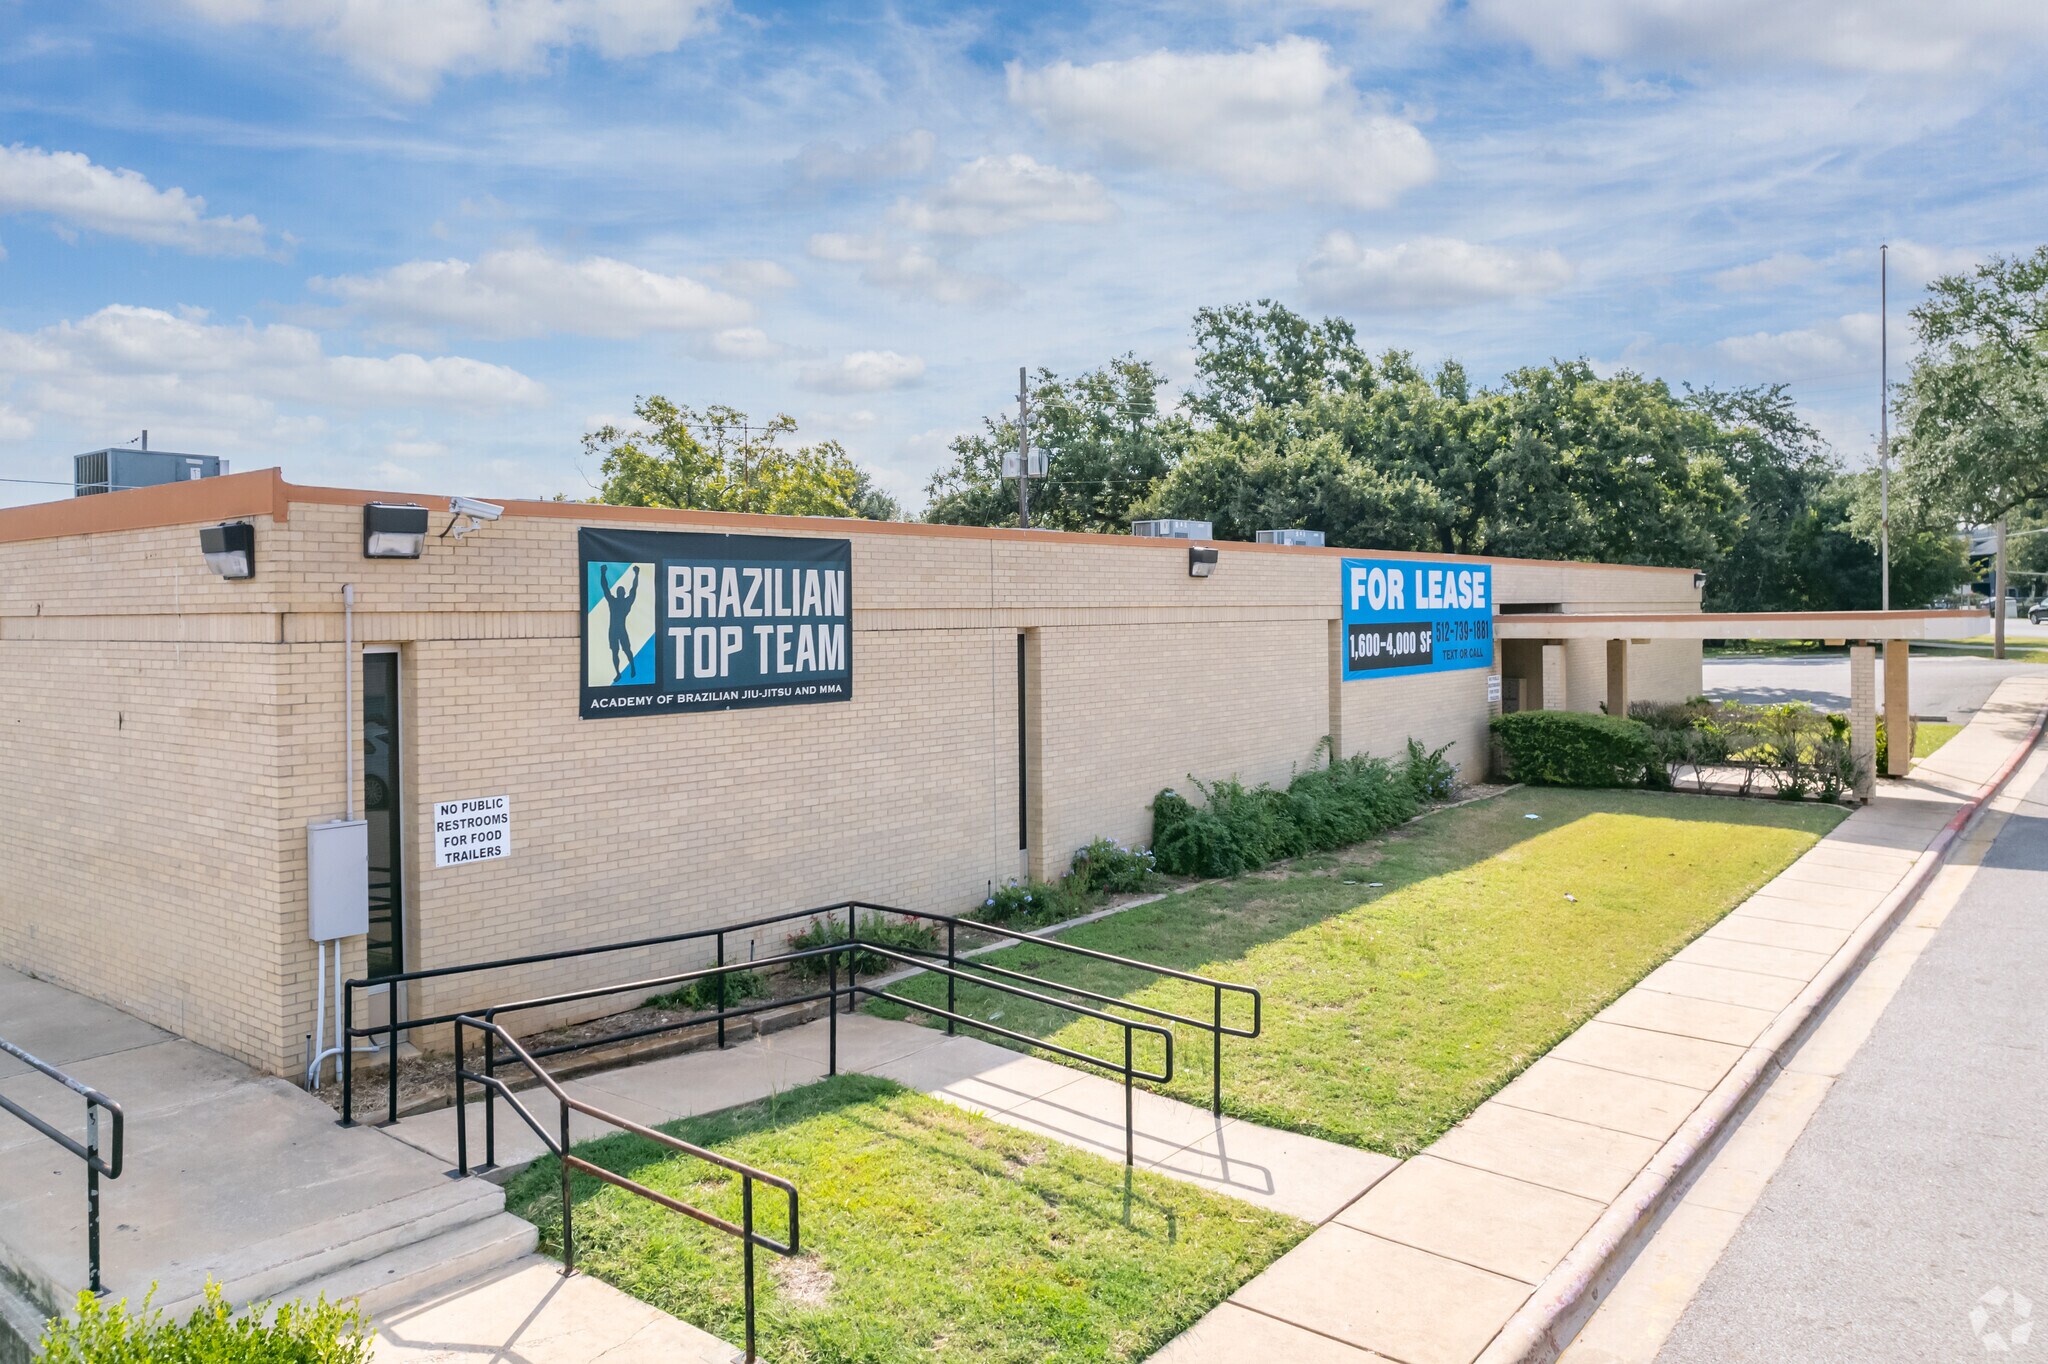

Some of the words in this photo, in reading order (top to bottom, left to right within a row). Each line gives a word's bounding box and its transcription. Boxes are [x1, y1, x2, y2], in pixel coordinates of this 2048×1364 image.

[667, 566, 845, 619] BRAZILIAN
[1351, 567, 1405, 611] FOR
[1415, 569, 1486, 609] LEASE
[1436, 620, 1489, 642] 512-739-1881
[667, 625, 743, 679] TOP
[753, 624, 845, 675] TEAM
[1350, 631, 1416, 661] 1,600-4,000
[1420, 630, 1432, 653] SF
[1443, 649, 1458, 661] TEXT
[1459, 648, 1468, 659] OR
[1469, 647, 1484, 658] CALL
[590, 696, 654, 709] ACADEMY
[656, 694, 674, 705] OF
[677, 690, 739, 703] BRAZILIAN
[741, 687, 792, 700] JIU-JITSU
[794, 686, 817, 696] AND
[819, 684, 842, 694] MMA
[441, 804, 457, 815] NO
[462, 798, 503, 812] PUBLIC
[437, 813, 508, 832] RESTROOMS
[444, 835, 467, 848] FOR
[471, 830, 502, 844] FOOD
[445, 846, 501, 863] TRAILERS
